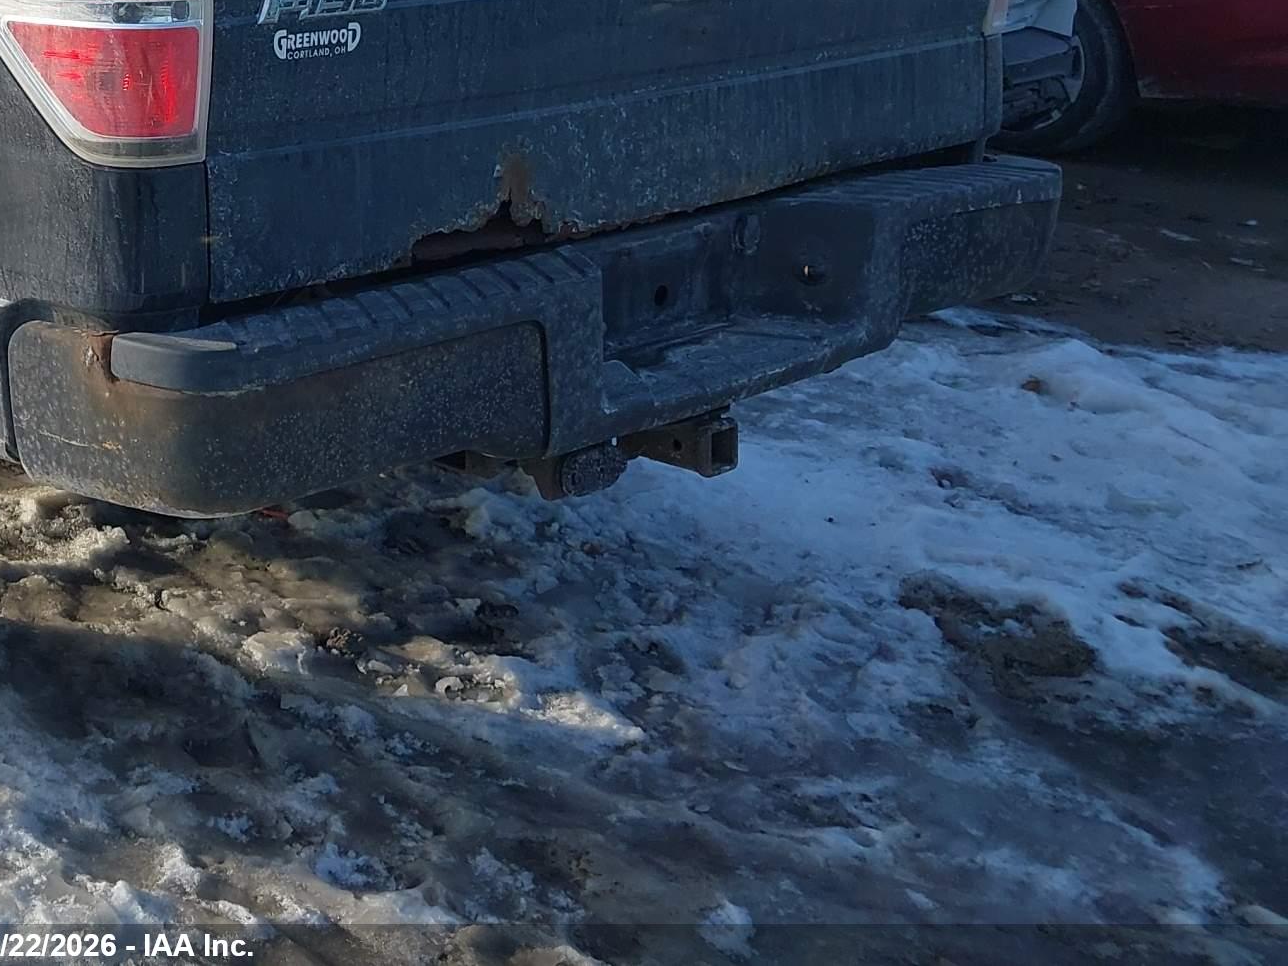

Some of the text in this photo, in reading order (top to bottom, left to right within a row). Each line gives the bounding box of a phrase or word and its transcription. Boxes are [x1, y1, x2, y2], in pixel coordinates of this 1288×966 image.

[273, 22, 362, 60] GREENWOOD
[287, 45, 347, 60] CORTLAND, OH
